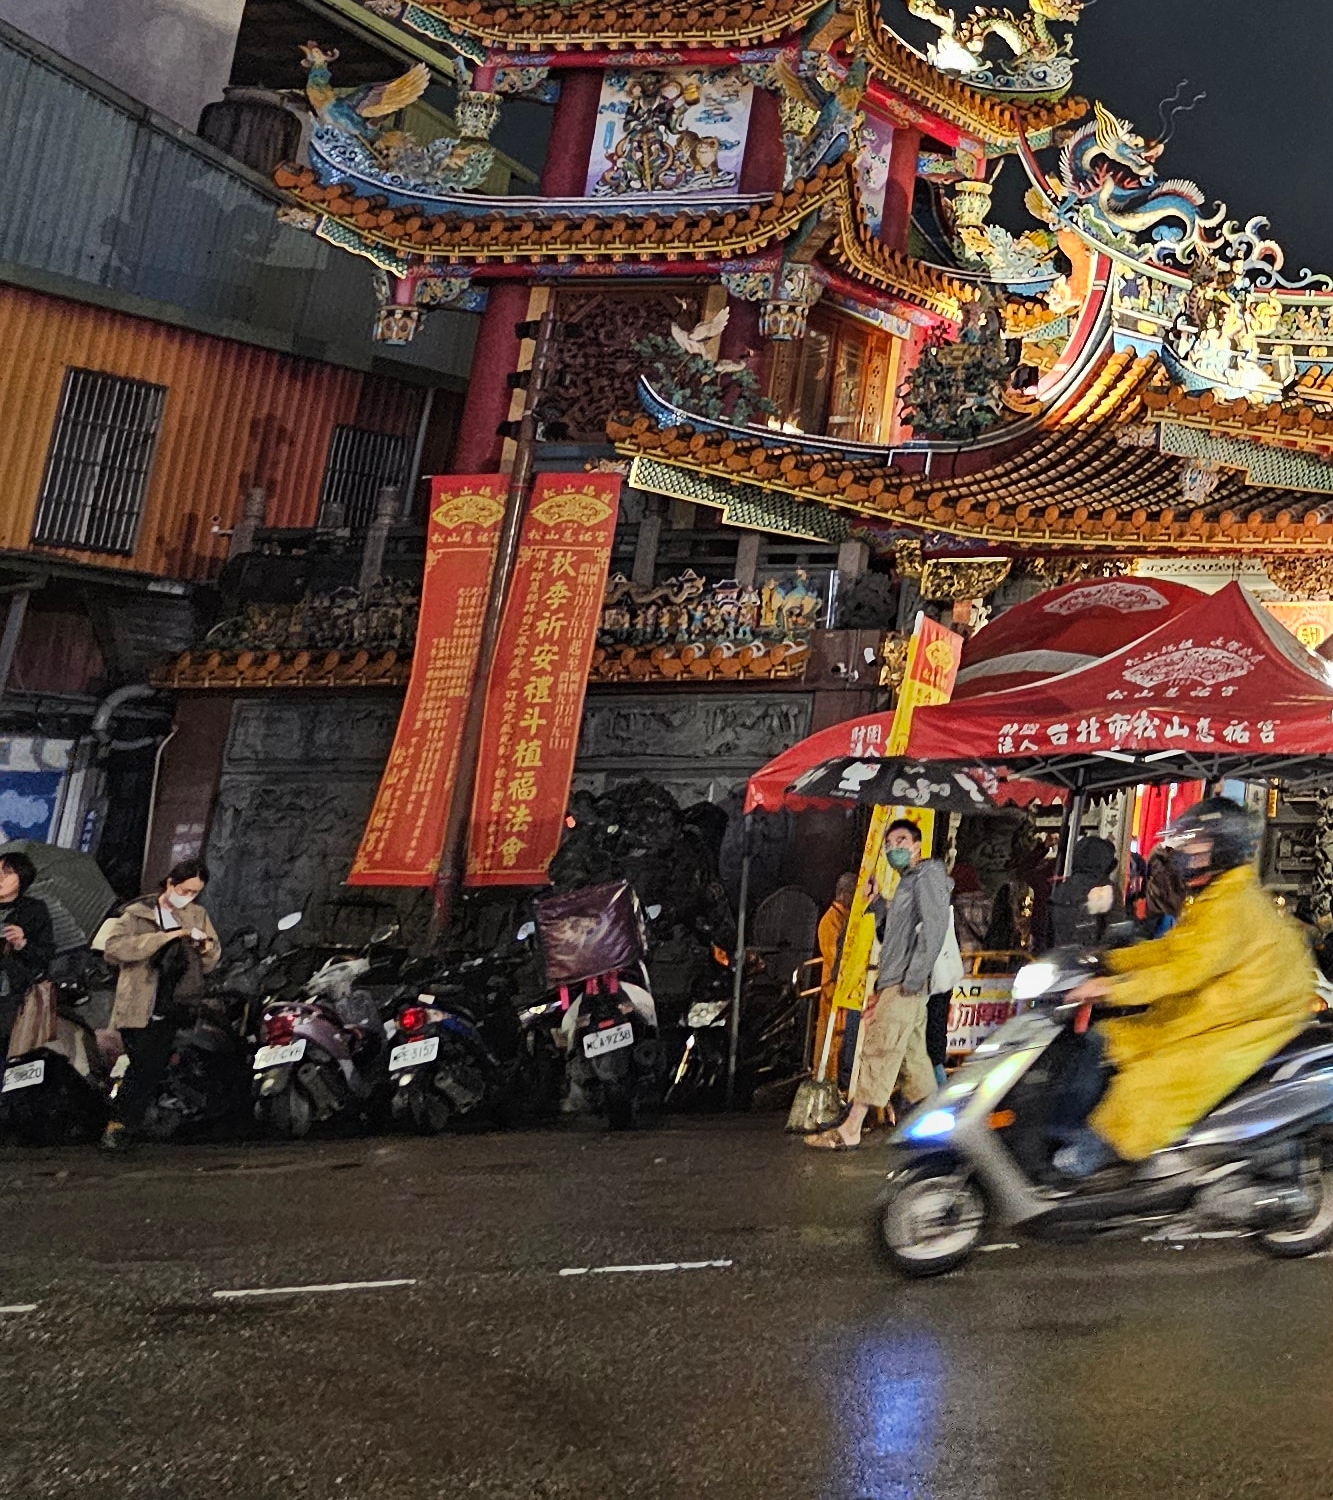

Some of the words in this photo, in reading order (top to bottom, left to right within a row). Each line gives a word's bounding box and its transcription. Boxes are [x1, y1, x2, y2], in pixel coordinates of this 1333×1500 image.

[500, 550, 577, 867] 秋季祈安禮斗植福法會
